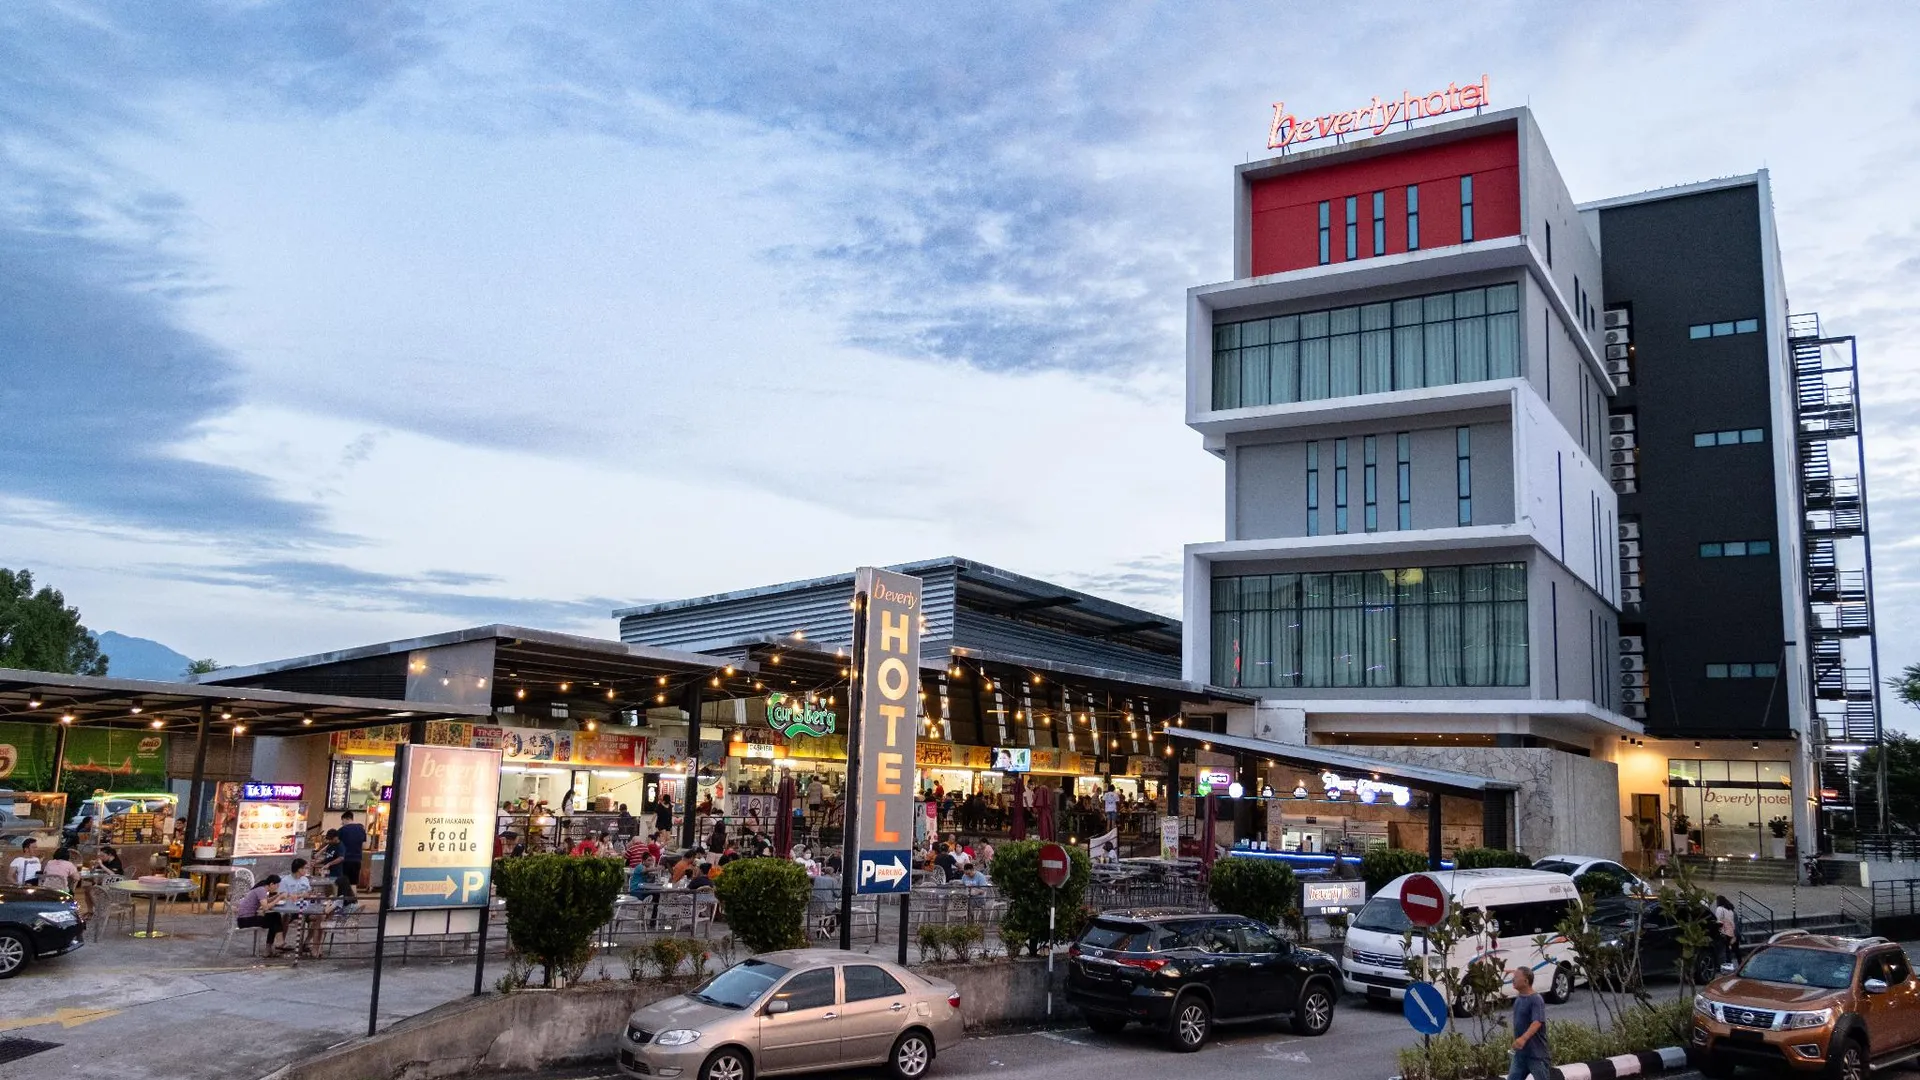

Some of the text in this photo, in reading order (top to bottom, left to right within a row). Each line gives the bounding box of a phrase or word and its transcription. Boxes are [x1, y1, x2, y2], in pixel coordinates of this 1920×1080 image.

[1267, 73, 1489, 149] beverly hotel
[874, 577, 917, 609] beverly
[767, 692, 836, 735] Carlsberg
[876, 610, 909, 843] HOTEL
[1704, 785, 1790, 806] beverly hotel
[418, 842, 477, 852] avenue
[430, 828, 467, 841] food
[406, 871, 484, 903] PARKING P
[861, 860, 875, 886] P
